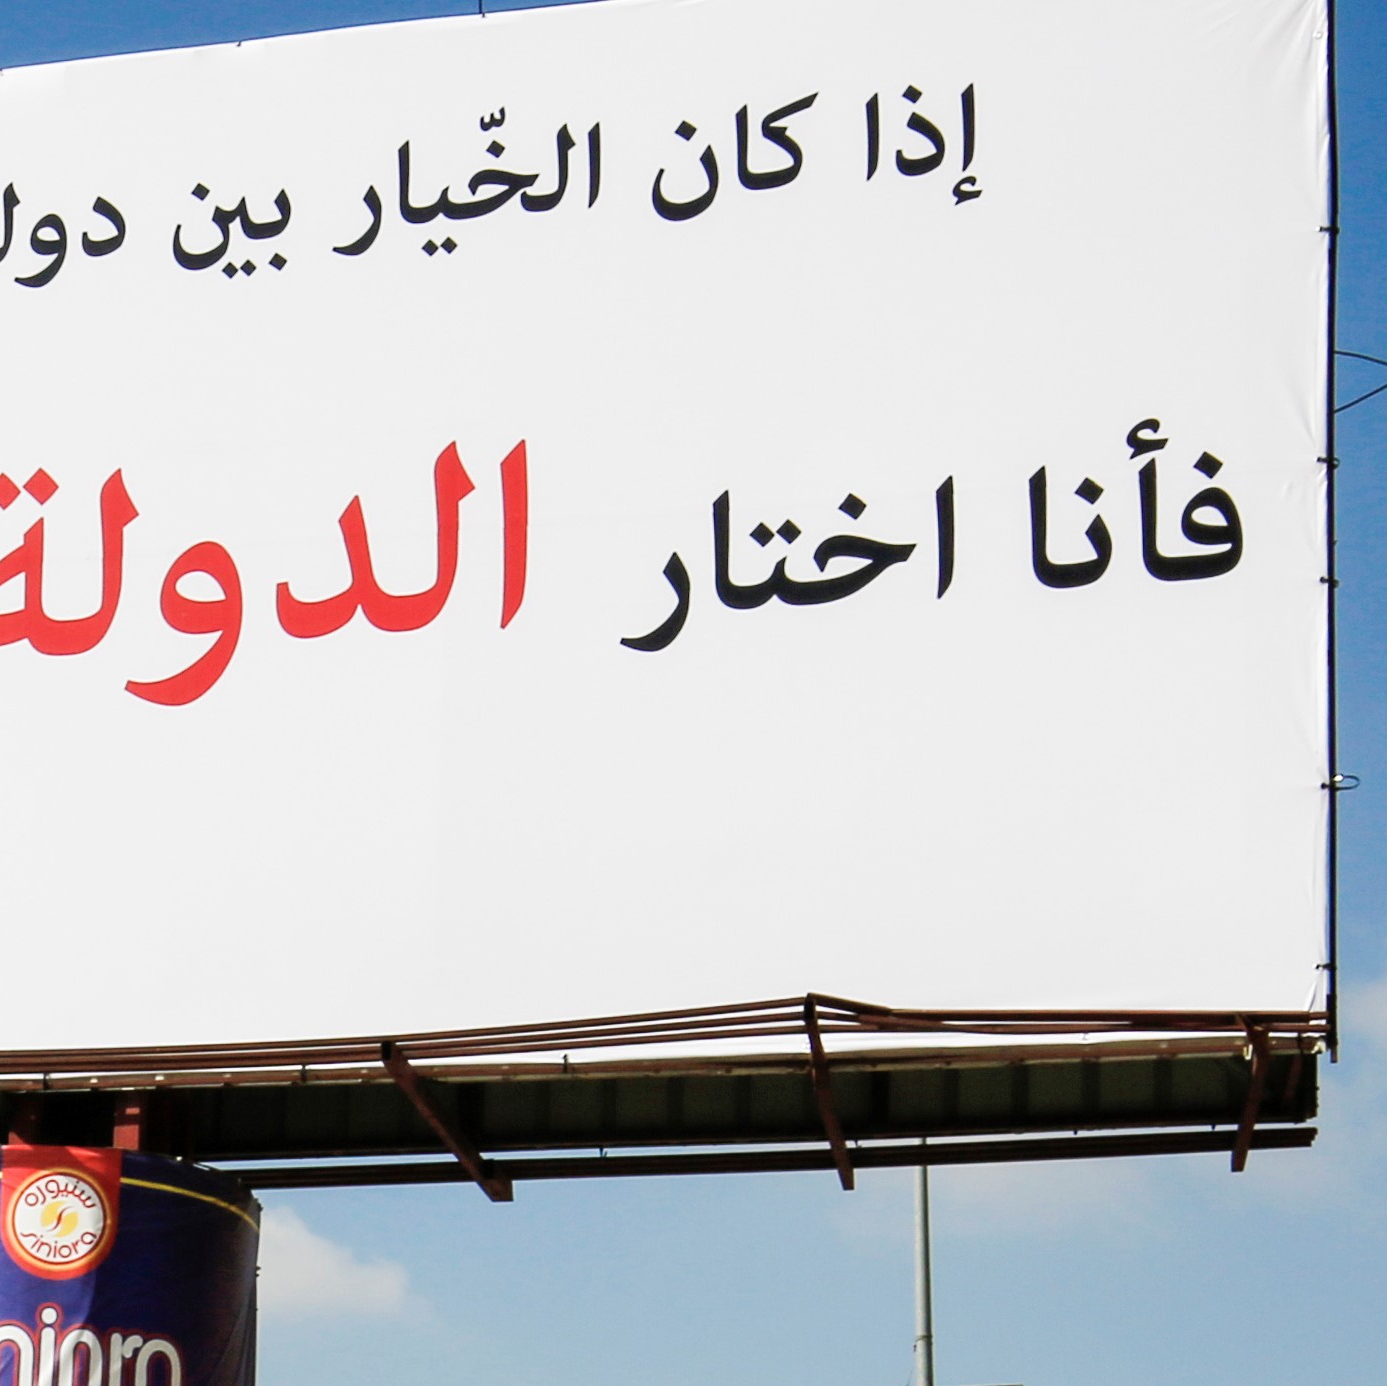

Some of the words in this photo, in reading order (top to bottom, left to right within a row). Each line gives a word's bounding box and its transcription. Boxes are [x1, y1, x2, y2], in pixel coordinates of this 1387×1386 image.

[652, 93, 818, 221] كان
[866, 84, 982, 205] إذا
[173, 183, 291, 278] بين
[620, 476, 954, 652] اختار
[1029, 418, 1243, 588] فأنا
